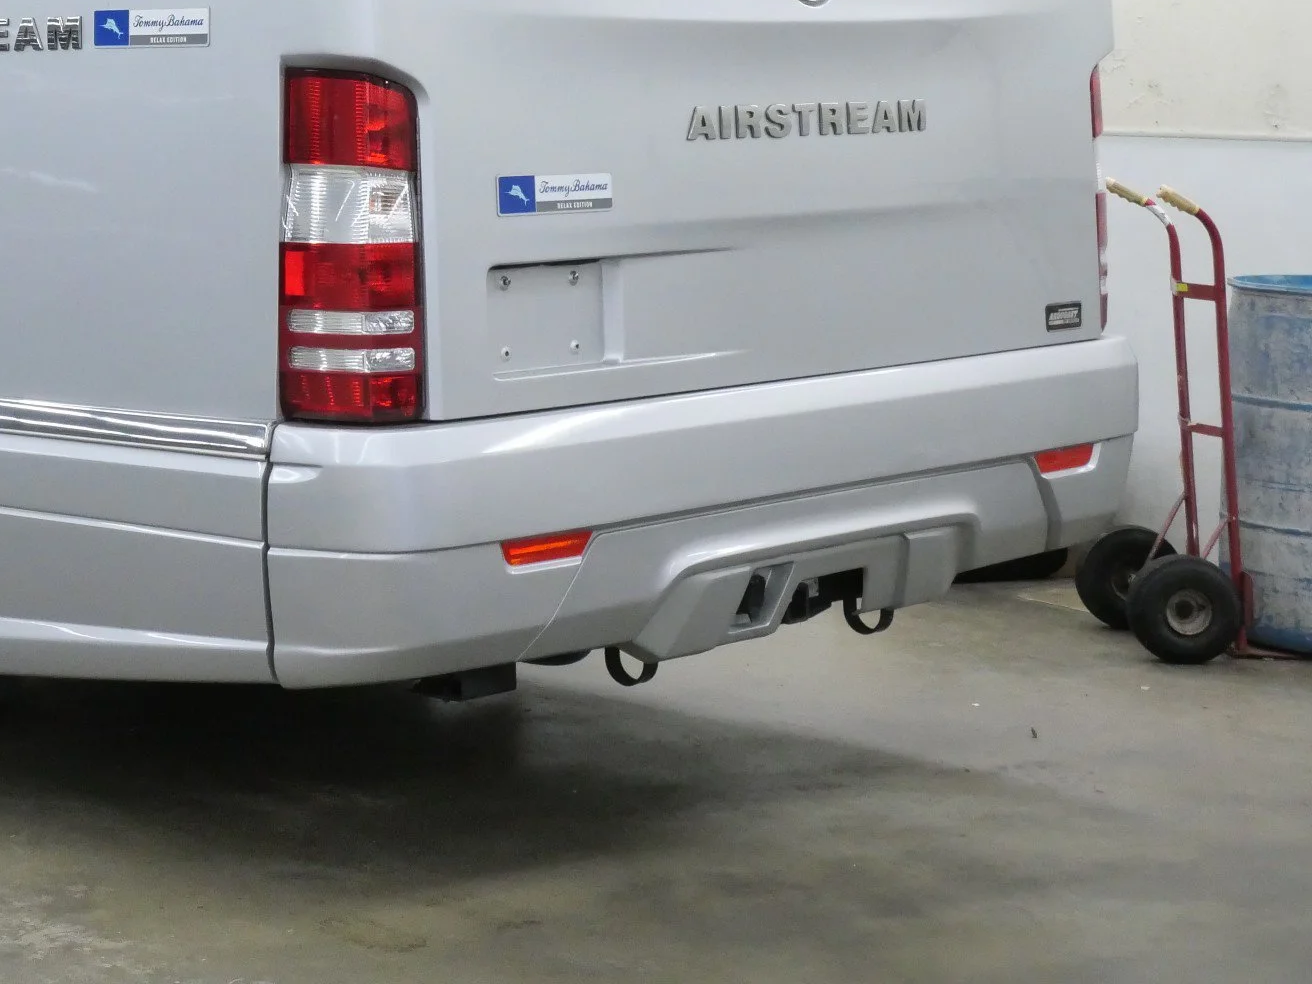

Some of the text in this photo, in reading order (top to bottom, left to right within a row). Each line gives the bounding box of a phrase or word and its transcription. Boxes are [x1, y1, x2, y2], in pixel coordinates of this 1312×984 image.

[133, 14, 205, 32] Tommy Bahama
[167, 35, 187, 44] EDITION
[686, 97, 927, 142] AIRSTREAM
[539, 179, 608, 197] Tommy Bahama
[573, 201, 593, 209] EDITION
